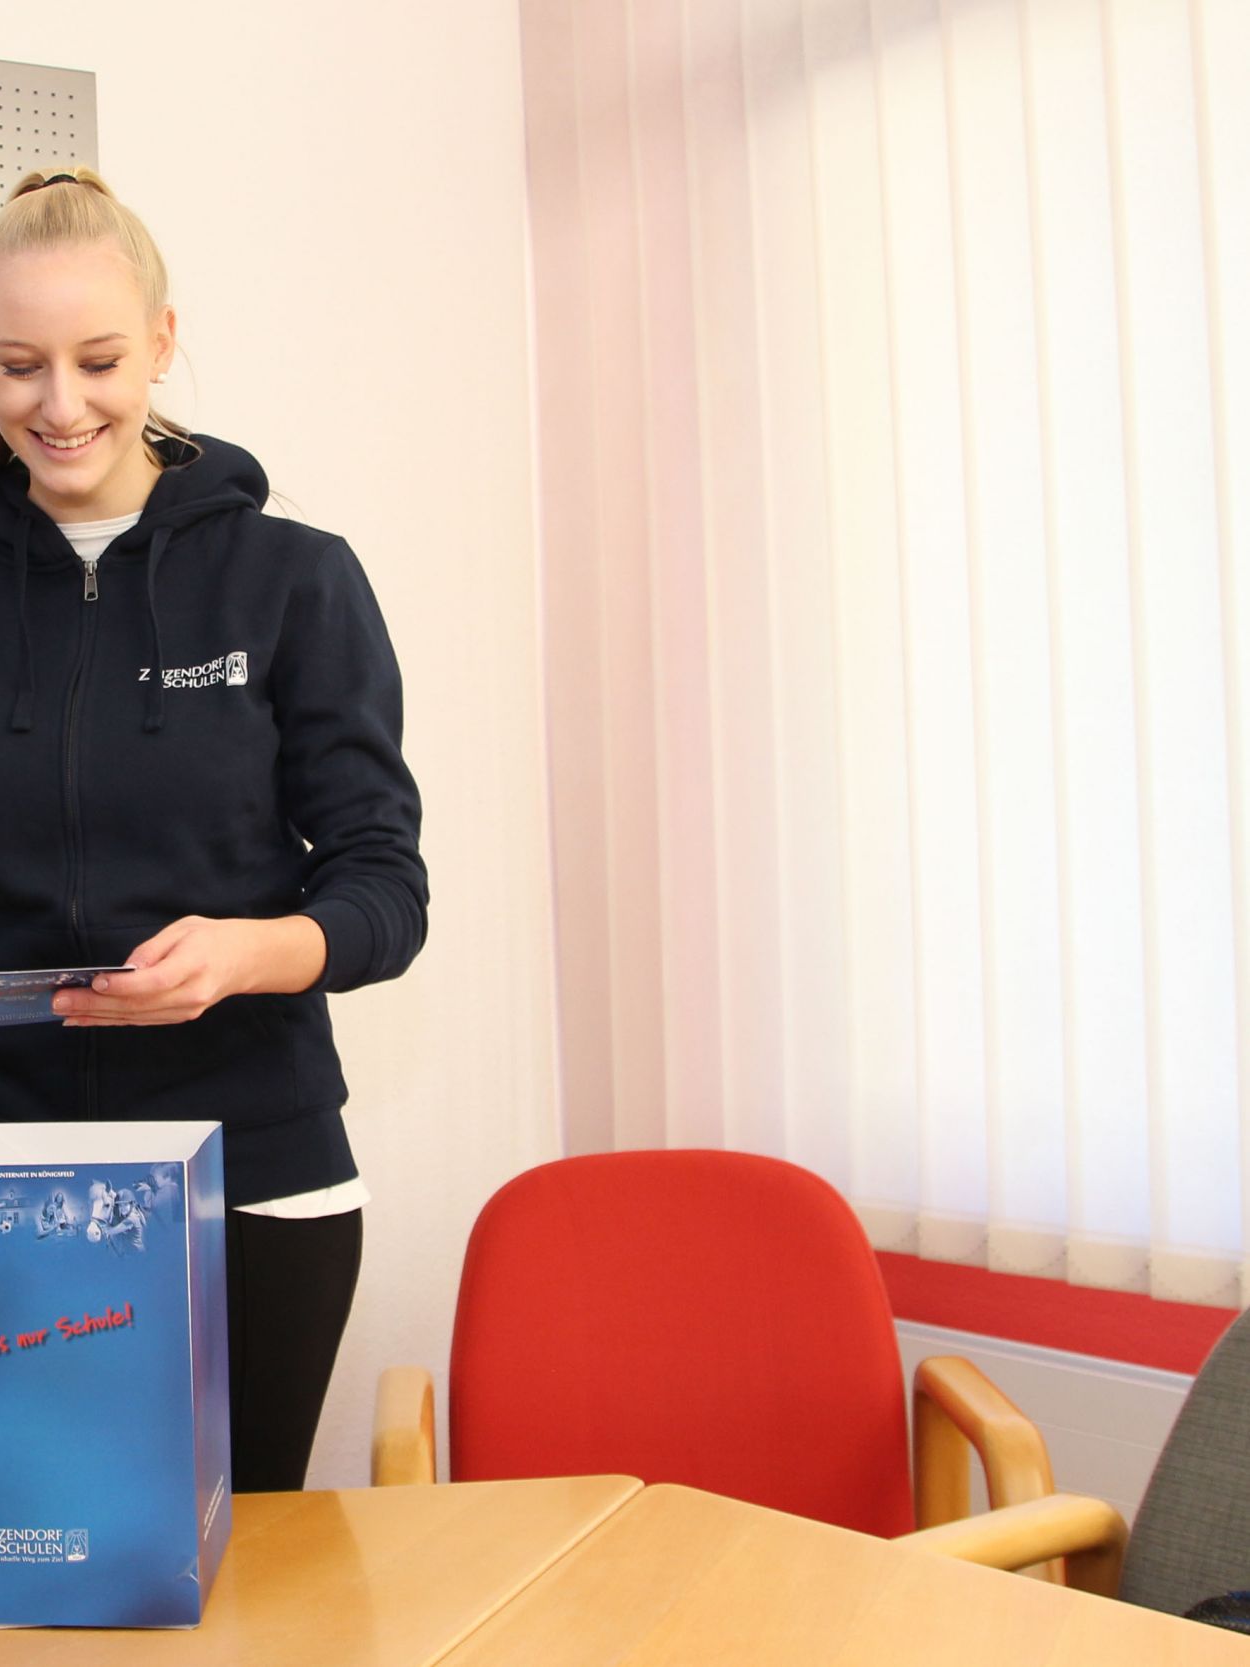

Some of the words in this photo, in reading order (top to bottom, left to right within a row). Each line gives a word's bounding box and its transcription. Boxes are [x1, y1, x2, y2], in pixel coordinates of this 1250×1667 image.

[162, 669, 225, 689] SCHULEN
[39, 1170, 75, 1178] KÖNIGSFELD
[17, 1327, 49, 1348] nur
[55, 1302, 134, 1341] Schule!
